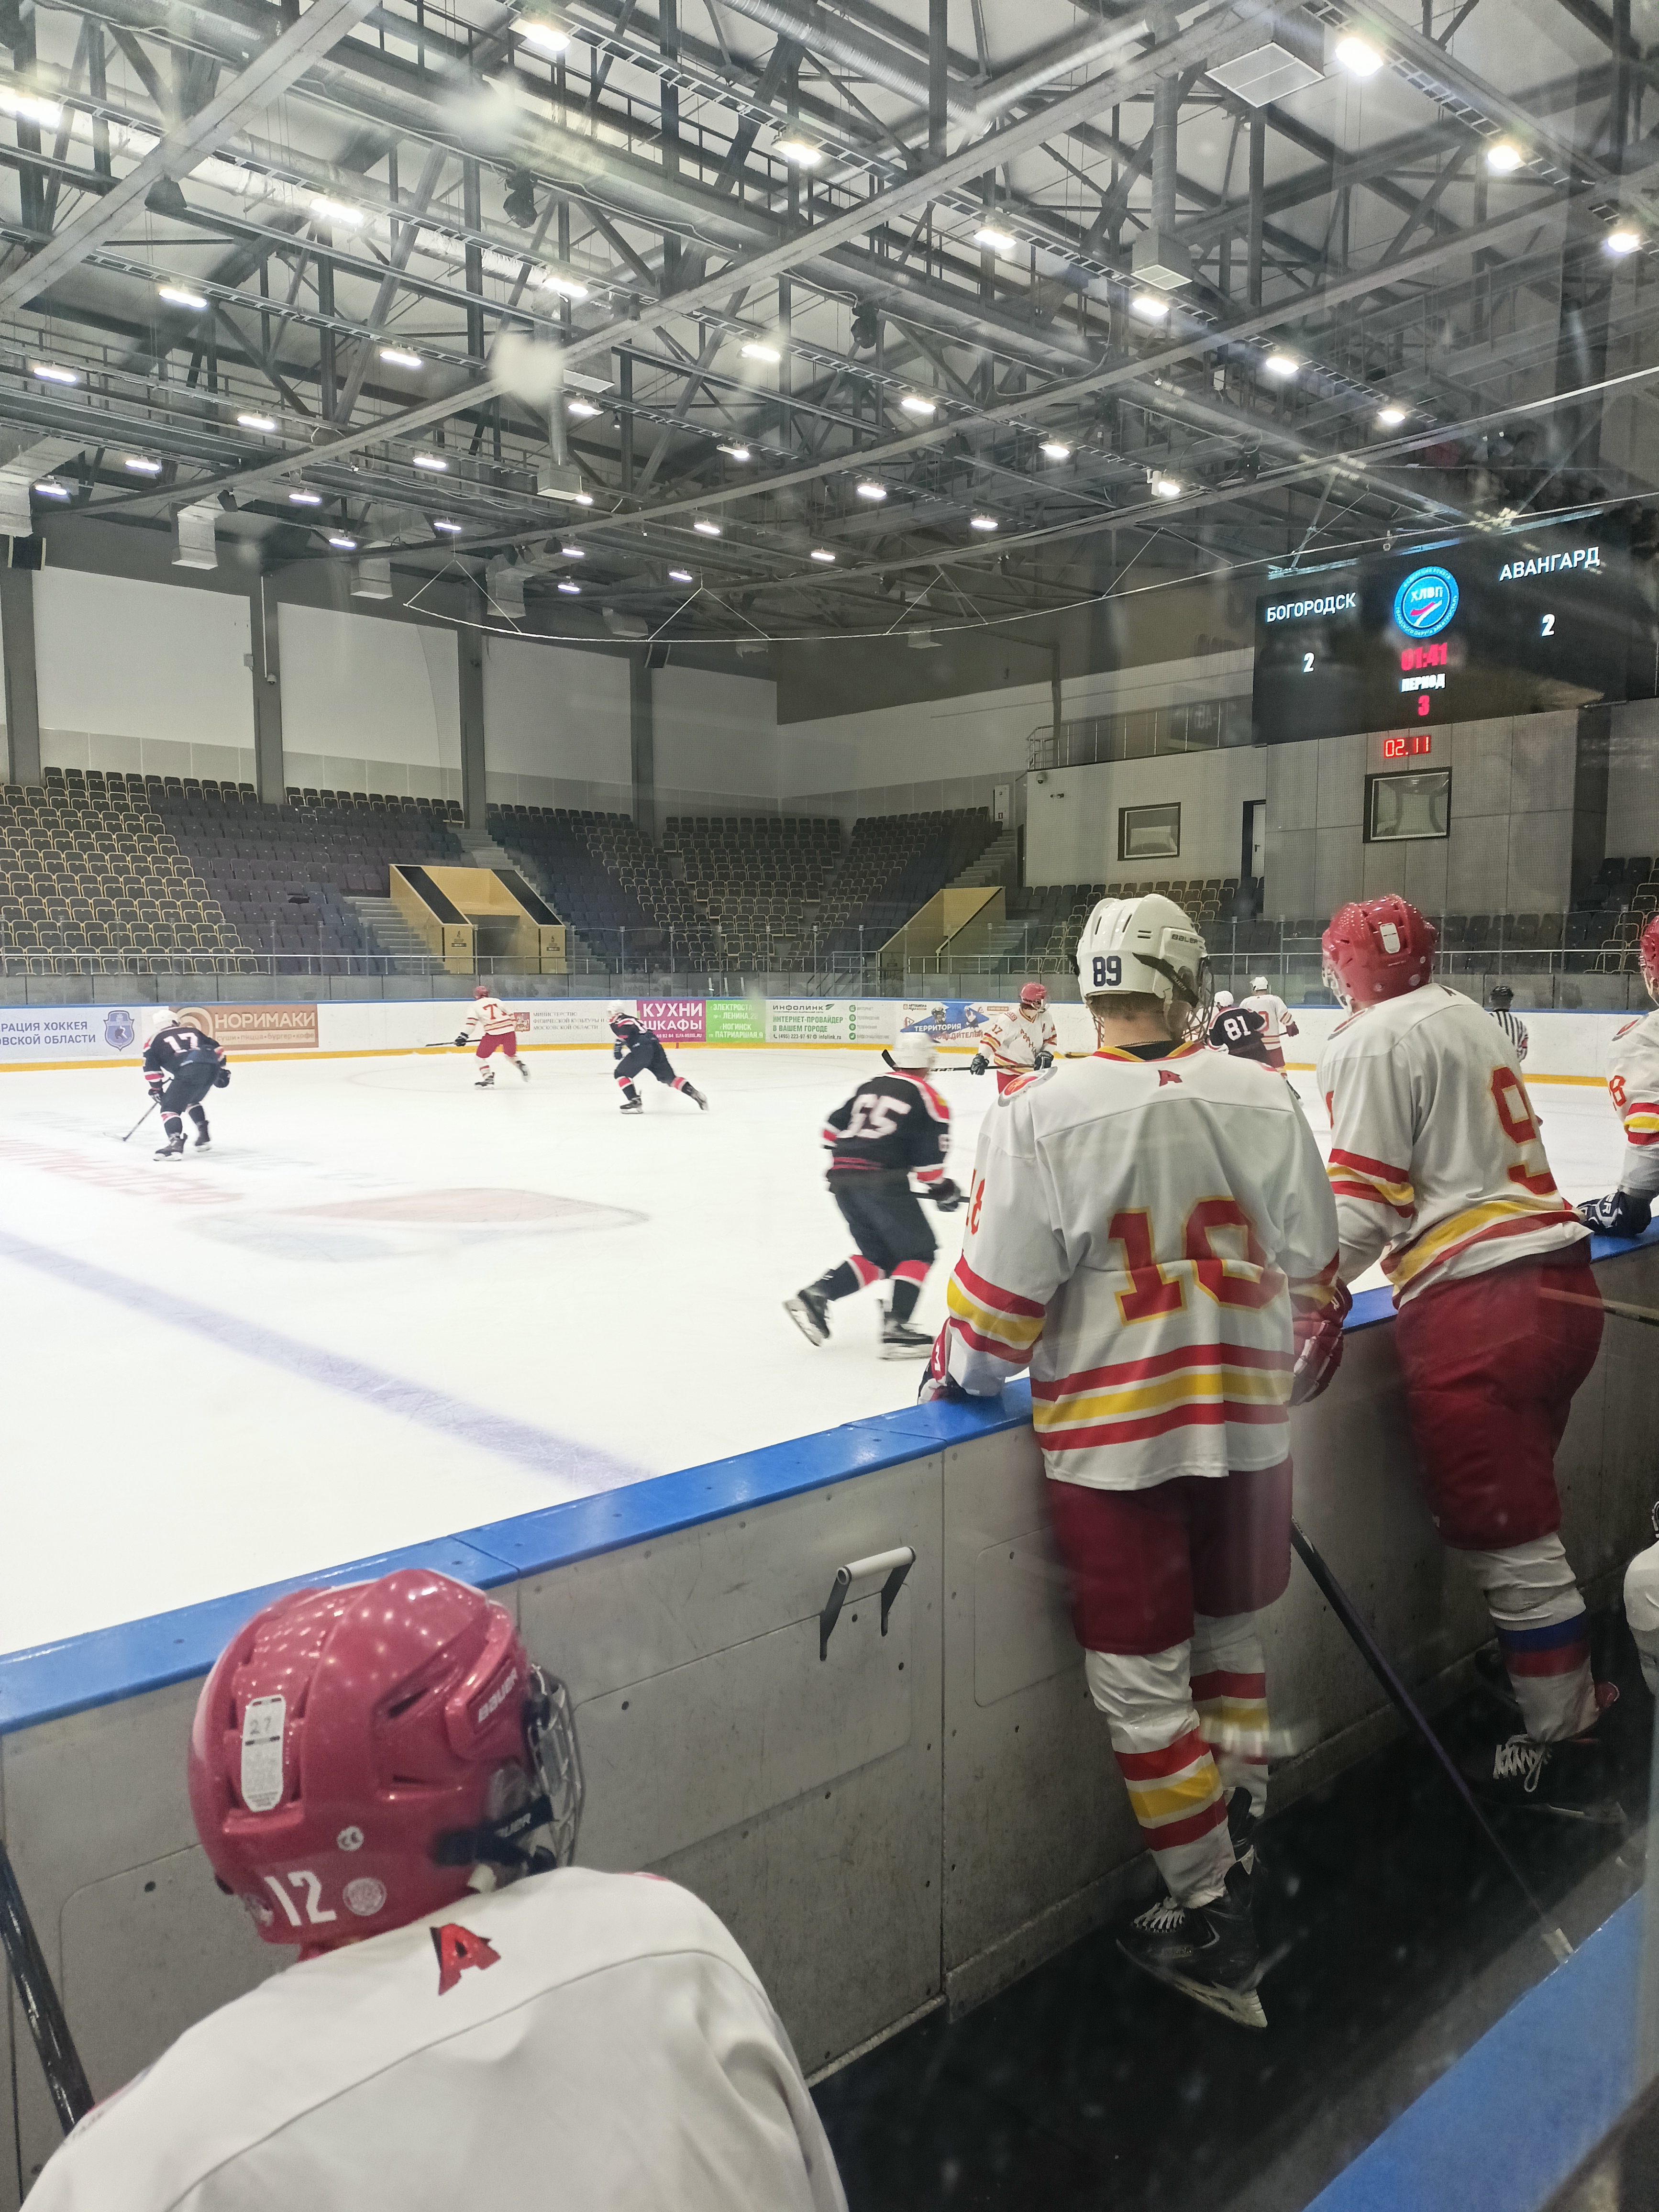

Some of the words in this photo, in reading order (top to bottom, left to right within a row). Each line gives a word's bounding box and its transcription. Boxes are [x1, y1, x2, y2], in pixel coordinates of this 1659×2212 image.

[1499, 546, 1600, 581] АВАНГАРД
[1267, 592, 1356, 622] БОГОРОДСК
[1541, 614, 1555, 637] 2
[1303, 652, 1315, 673] 2
[1401, 642, 1448, 671] 01:41
[1401, 673, 1445, 693] ПЕРИОД
[1417, 695, 1430, 716] 3
[1092, 955, 1122, 987] 89
[482, 1003, 498, 1019] 7
[643, 1003, 702, 1017] КУХНИ
[773, 1015, 843, 1024] ИНТЕРНЕТ-ПРОВАЙДЕР
[0, 1022, 40, 1032] РАЦИЯ
[44, 1021, 88, 1030] ХОККЕЯ
[215, 1012, 315, 1029] НОРИМАКИ
[643, 1018, 702, 1031] ШКАФЫ
[914, 1023, 962, 1032] ТЕРРИТОРИЯ
[992, 1024, 1003, 1035] 17
[1223, 1015, 1251, 1041] 81
[44, 1034, 96, 1044] ОБЛАСТИ
[163, 1032, 201, 1053] 17
[267, 1032, 292, 1040] бургер
[296, 1031, 314, 1040] кофе
[264, 1869, 337, 1927] 12
